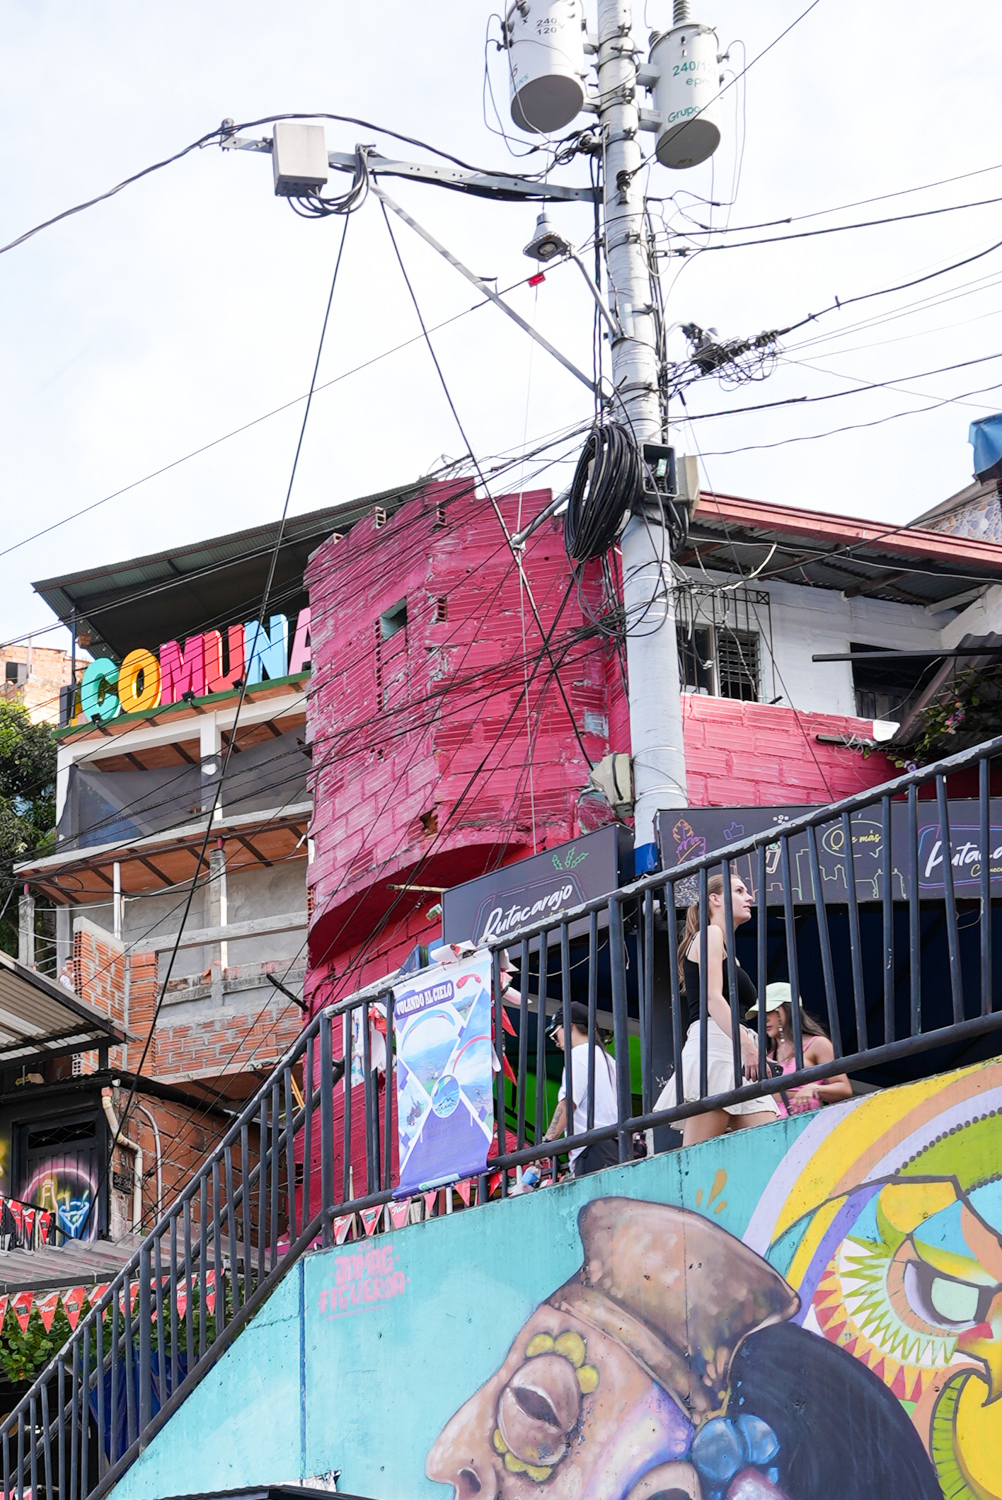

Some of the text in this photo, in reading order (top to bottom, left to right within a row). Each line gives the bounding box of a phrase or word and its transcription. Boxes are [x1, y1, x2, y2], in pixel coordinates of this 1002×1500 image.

[667, 105, 701, 123] Grupo
[434, 981, 453, 1002] CIELO
[318, 1270, 405, 1315] FIGUEROA
